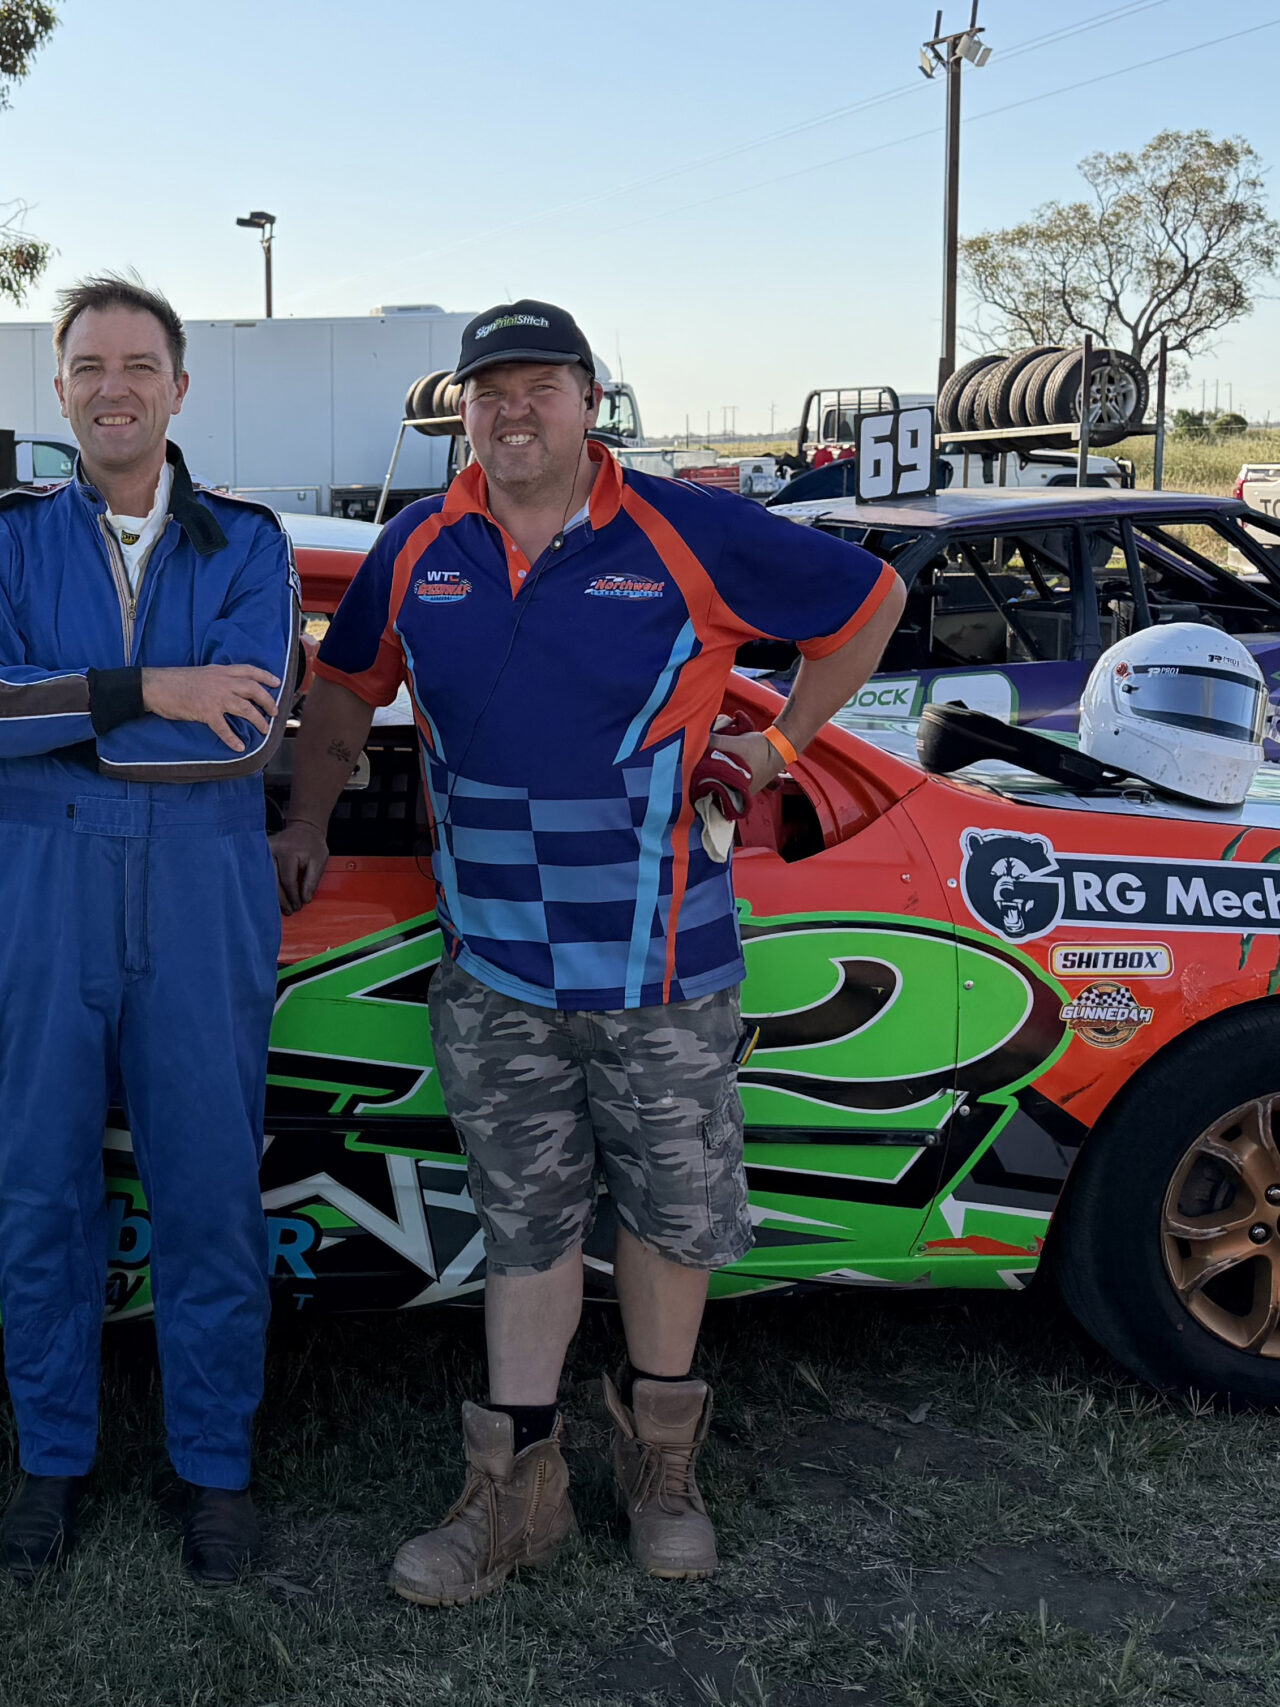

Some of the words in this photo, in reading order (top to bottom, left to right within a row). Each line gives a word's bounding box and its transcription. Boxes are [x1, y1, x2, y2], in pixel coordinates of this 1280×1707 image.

[859, 408, 932, 499] 69
[427, 571, 460, 582] WTC
[595, 579, 665, 591] Northwest
[1072, 871, 1146, 915] RG
[1166, 876, 1280, 919] Mech
[1062, 1006, 1152, 1022] GUNNEDAH
